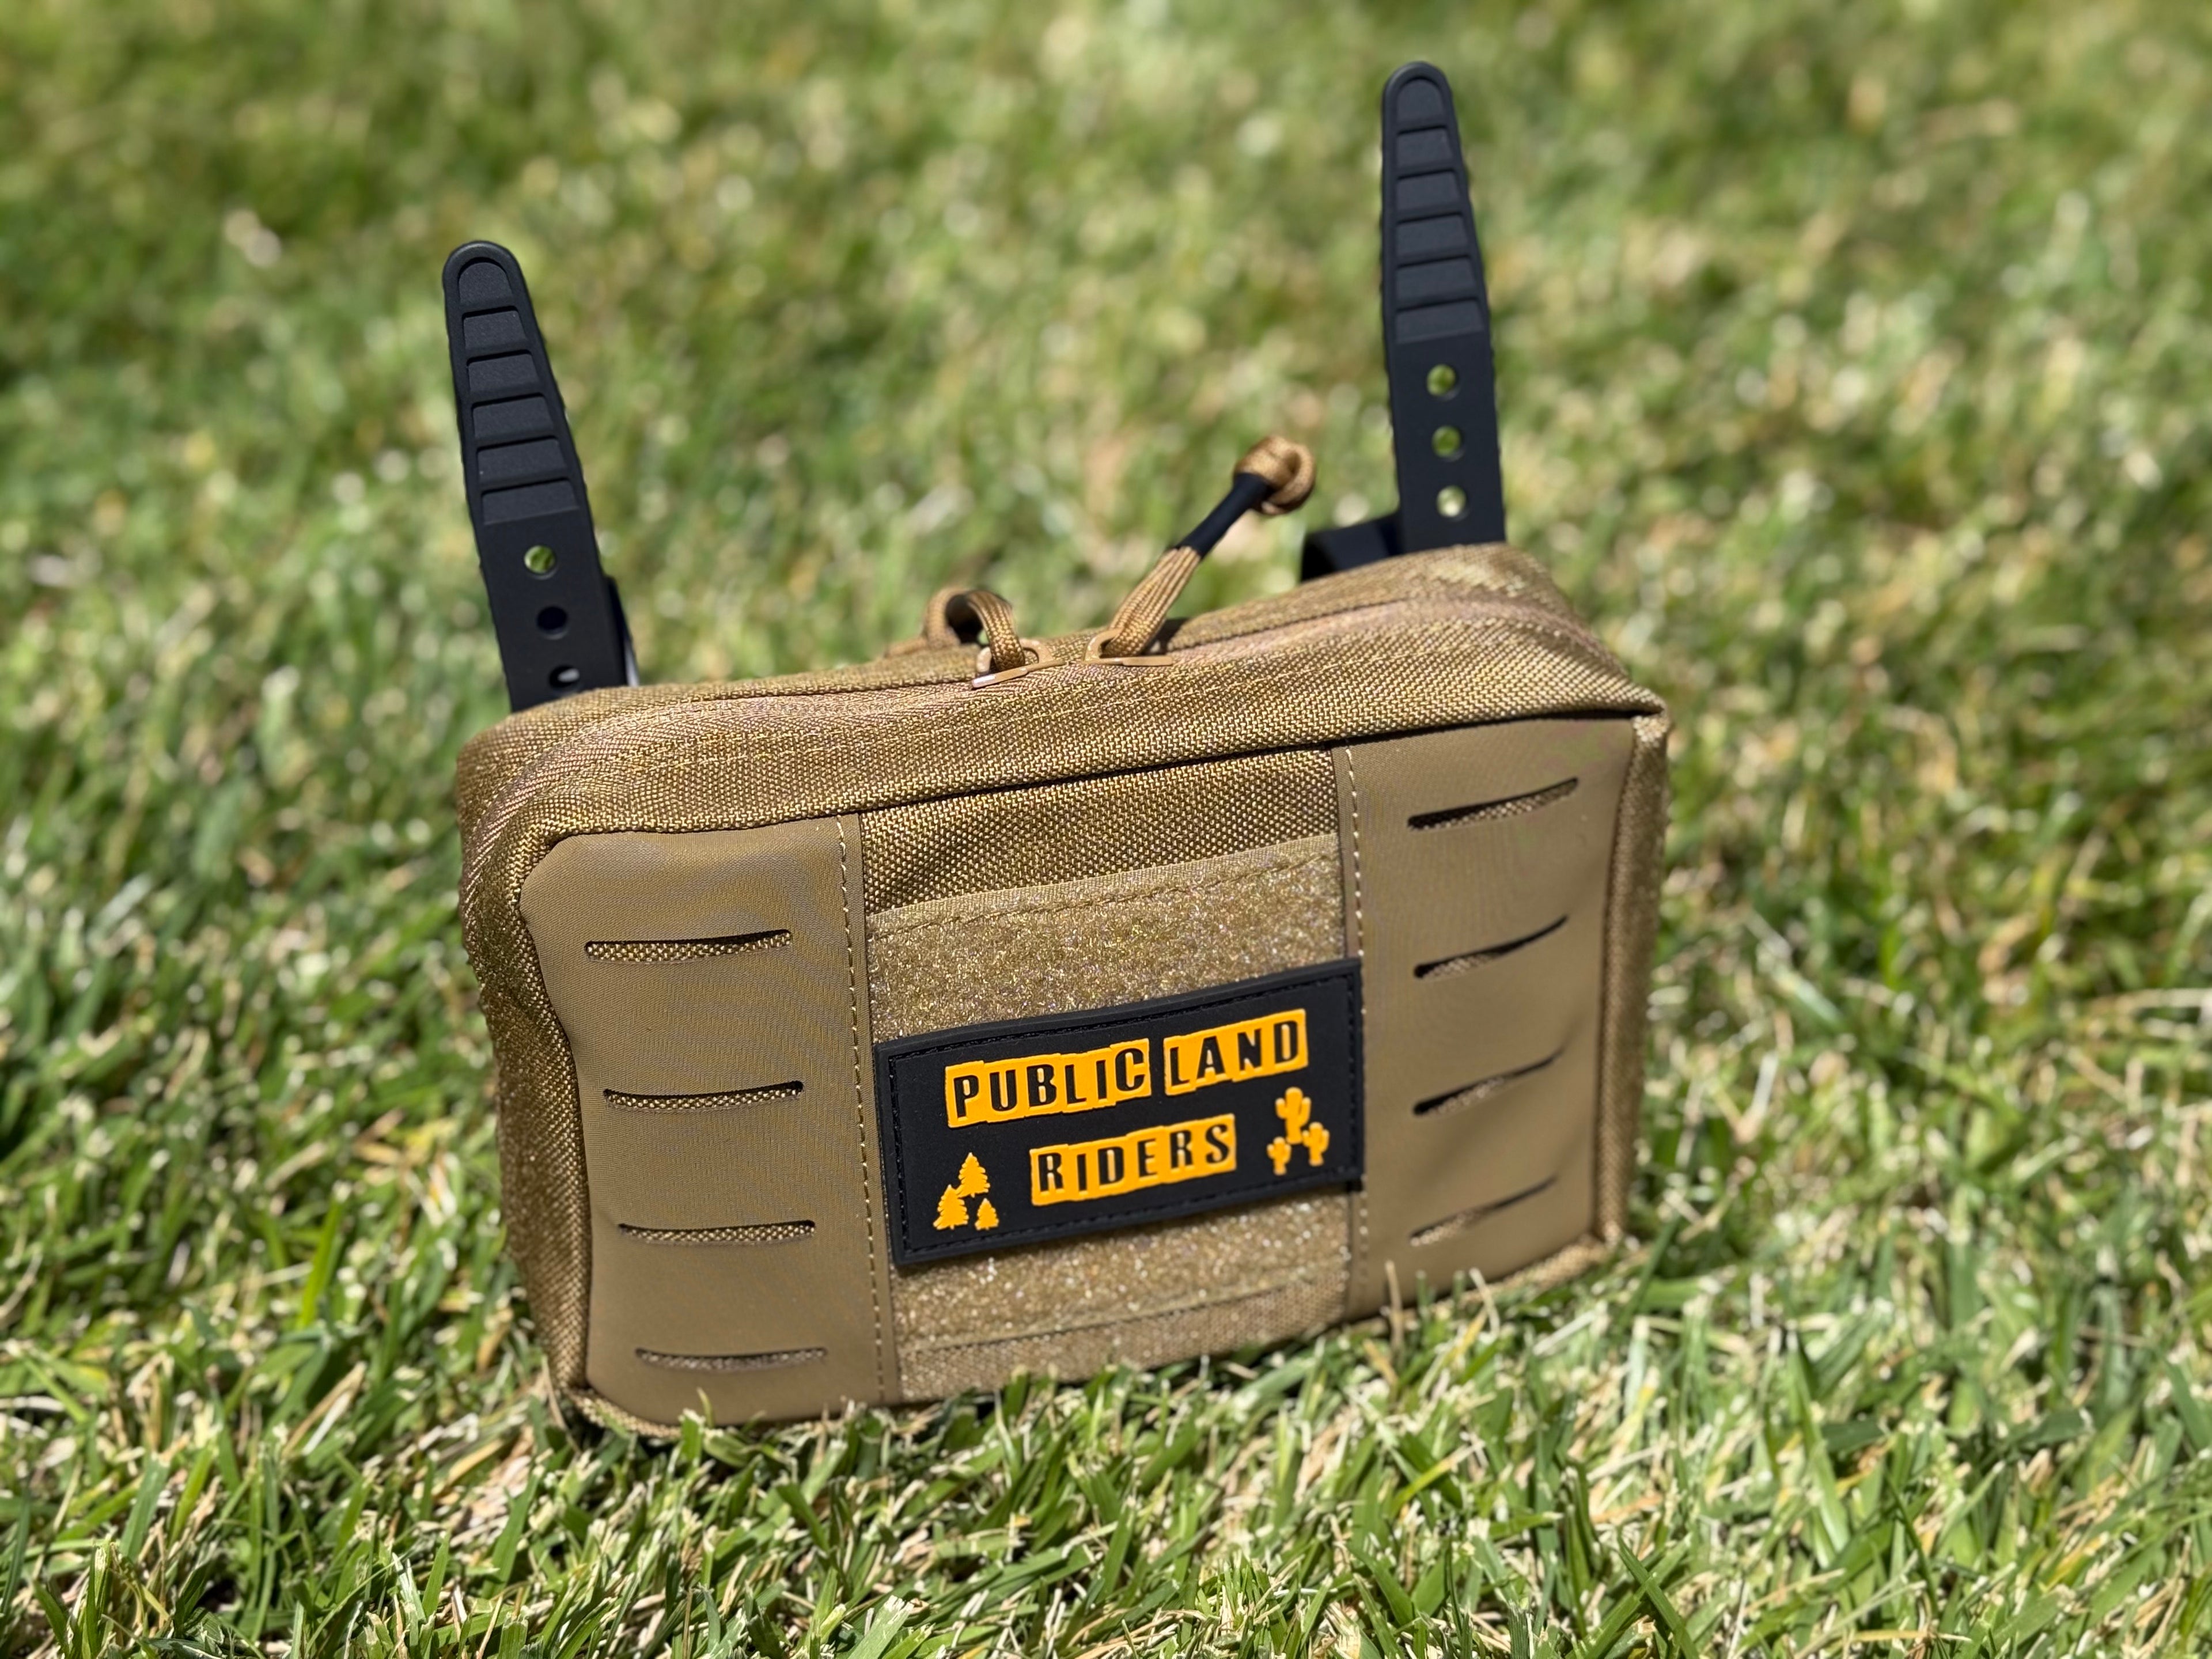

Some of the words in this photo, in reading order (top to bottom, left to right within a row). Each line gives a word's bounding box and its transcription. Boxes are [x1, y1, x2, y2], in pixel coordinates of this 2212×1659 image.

[953, 1048, 1146, 1119] PUBLIC
[1168, 1020, 1301, 1085] LAND
[1037, 1124, 1230, 1192] RIDERS
